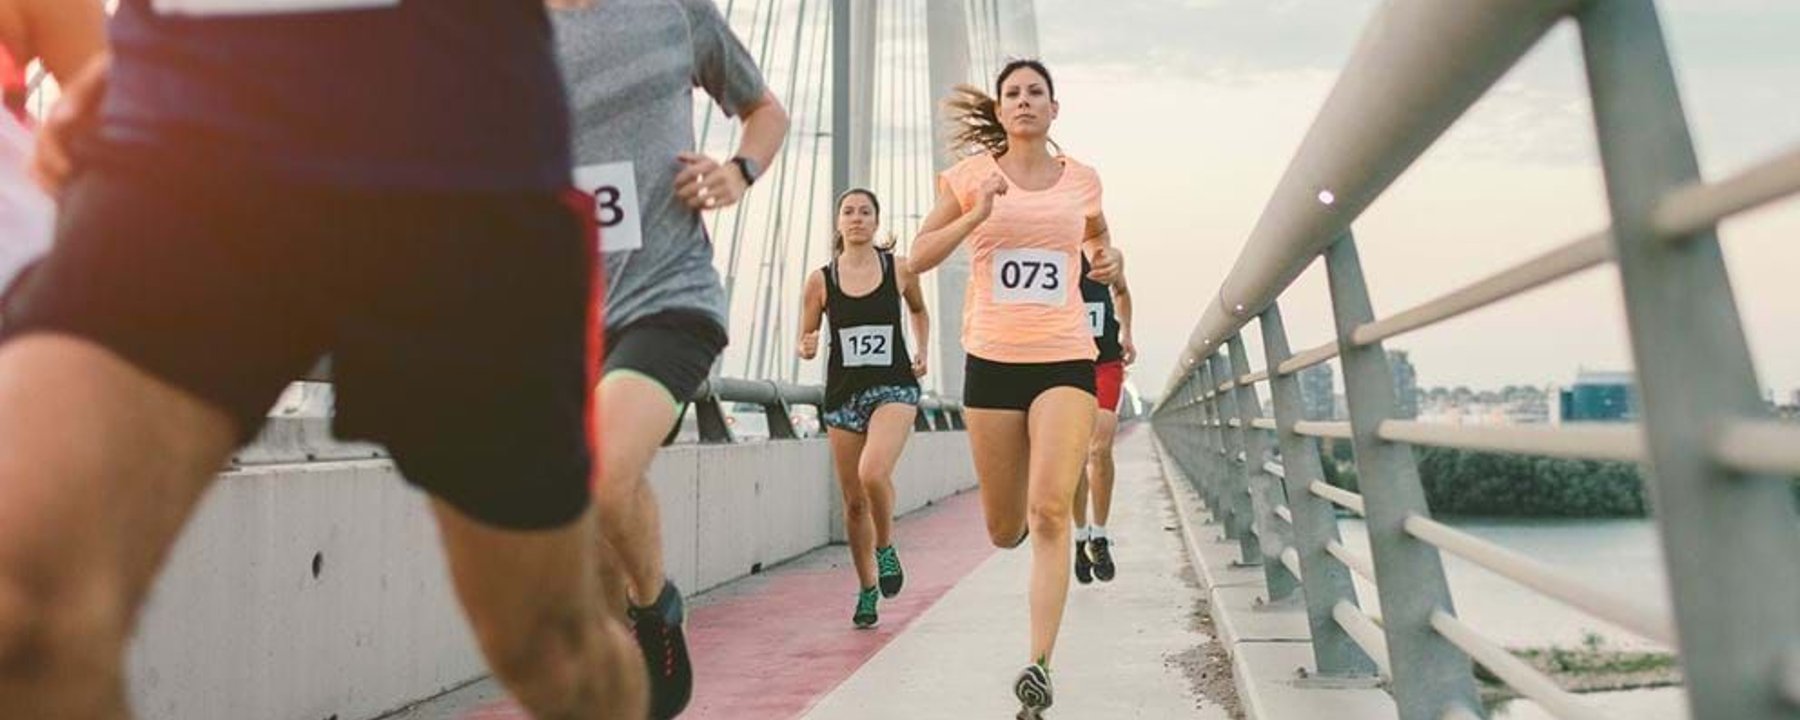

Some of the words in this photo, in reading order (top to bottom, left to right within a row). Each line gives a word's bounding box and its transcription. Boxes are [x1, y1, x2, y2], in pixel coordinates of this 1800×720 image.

[594, 186, 624, 228] 3
[1001, 260, 1059, 290] 073
[848, 334, 886, 356] 152
